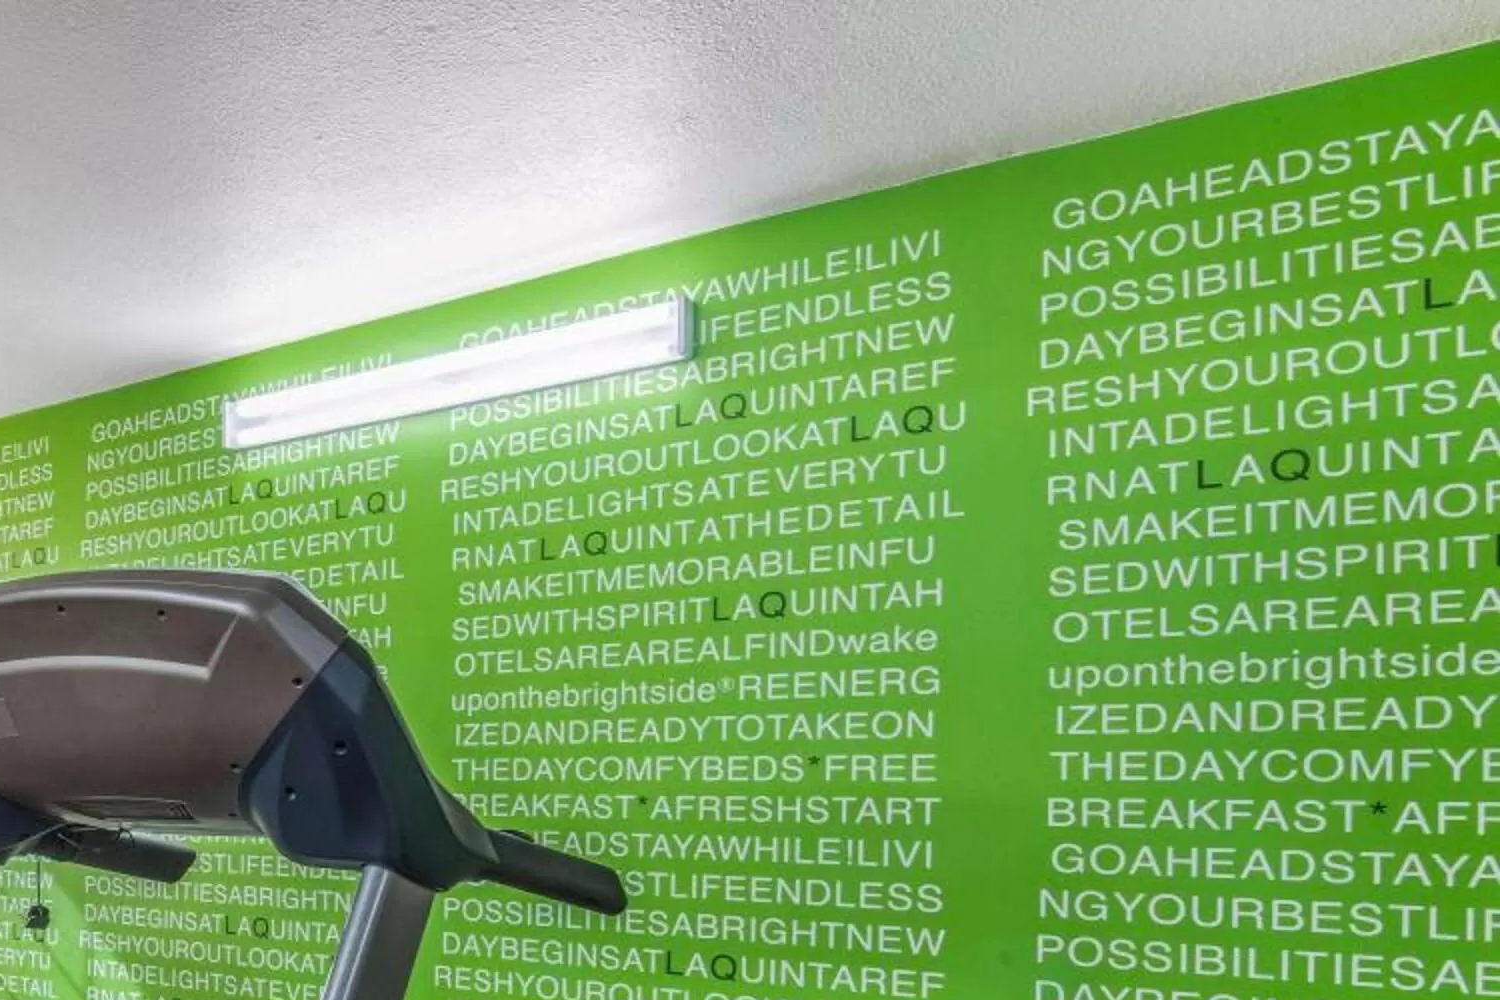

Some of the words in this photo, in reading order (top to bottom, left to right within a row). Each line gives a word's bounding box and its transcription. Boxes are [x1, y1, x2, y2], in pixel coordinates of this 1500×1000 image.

[1053, 108, 1500, 231] GOAHEADSTAYA
[1039, 267, 1498, 371] DAYBEGINSATLA
[449, 313, 956, 433] POSSIBILITIESABRIGHTNEW
[448, 357, 956, 469] DAYBEGINSATLAQUINTAREF
[1048, 373, 1500, 459] INTADELIGHTSA
[85, 421, 400, 502] POSSIBILITIESABRIGHTNEW
[440, 401, 967, 503] RESHYOUROUTLOOKATLAQU
[1047, 427, 1500, 506] RNATLAQUINTA
[79, 489, 408, 559] RESHYOUROUTLOOKATLAQU
[85, 455, 401, 530] DAYBEGINSATLAQUINTAREF
[452, 445, 947, 536] INTADELIGHTSATEVERYTU
[451, 489, 965, 572] RNATLAQUINTATHEDETAIL
[1048, 533, 1500, 598] SEDWITHSPIRIT
[458, 535, 935, 606] SMAKEITMEMORABLEINFU
[451, 578, 944, 642] SEDWITHSPIRITLAQUINTAH
[1052, 587, 1500, 643] OTELSAREAREA
[454, 624, 938, 678] OTELSAREAREALFINDwake
[1048, 641, 1500, 697] uponthebrightside
[454, 709, 935, 748] IZEDANDREADYTOTAKEON
[1056, 693, 1499, 735] IZEDANDREADY
[617, 870, 945, 914] STLIFEENDLESS
[1051, 843, 1500, 889] GOAHEADSTAYA
[84, 903, 341, 945] DAYBEGINSATLAQUINTA
[442, 897, 947, 957] POSSIBILITIESABRIGHTNEW
[441, 931, 946, 999] DAYBEGINSATLAQUINTAREF
